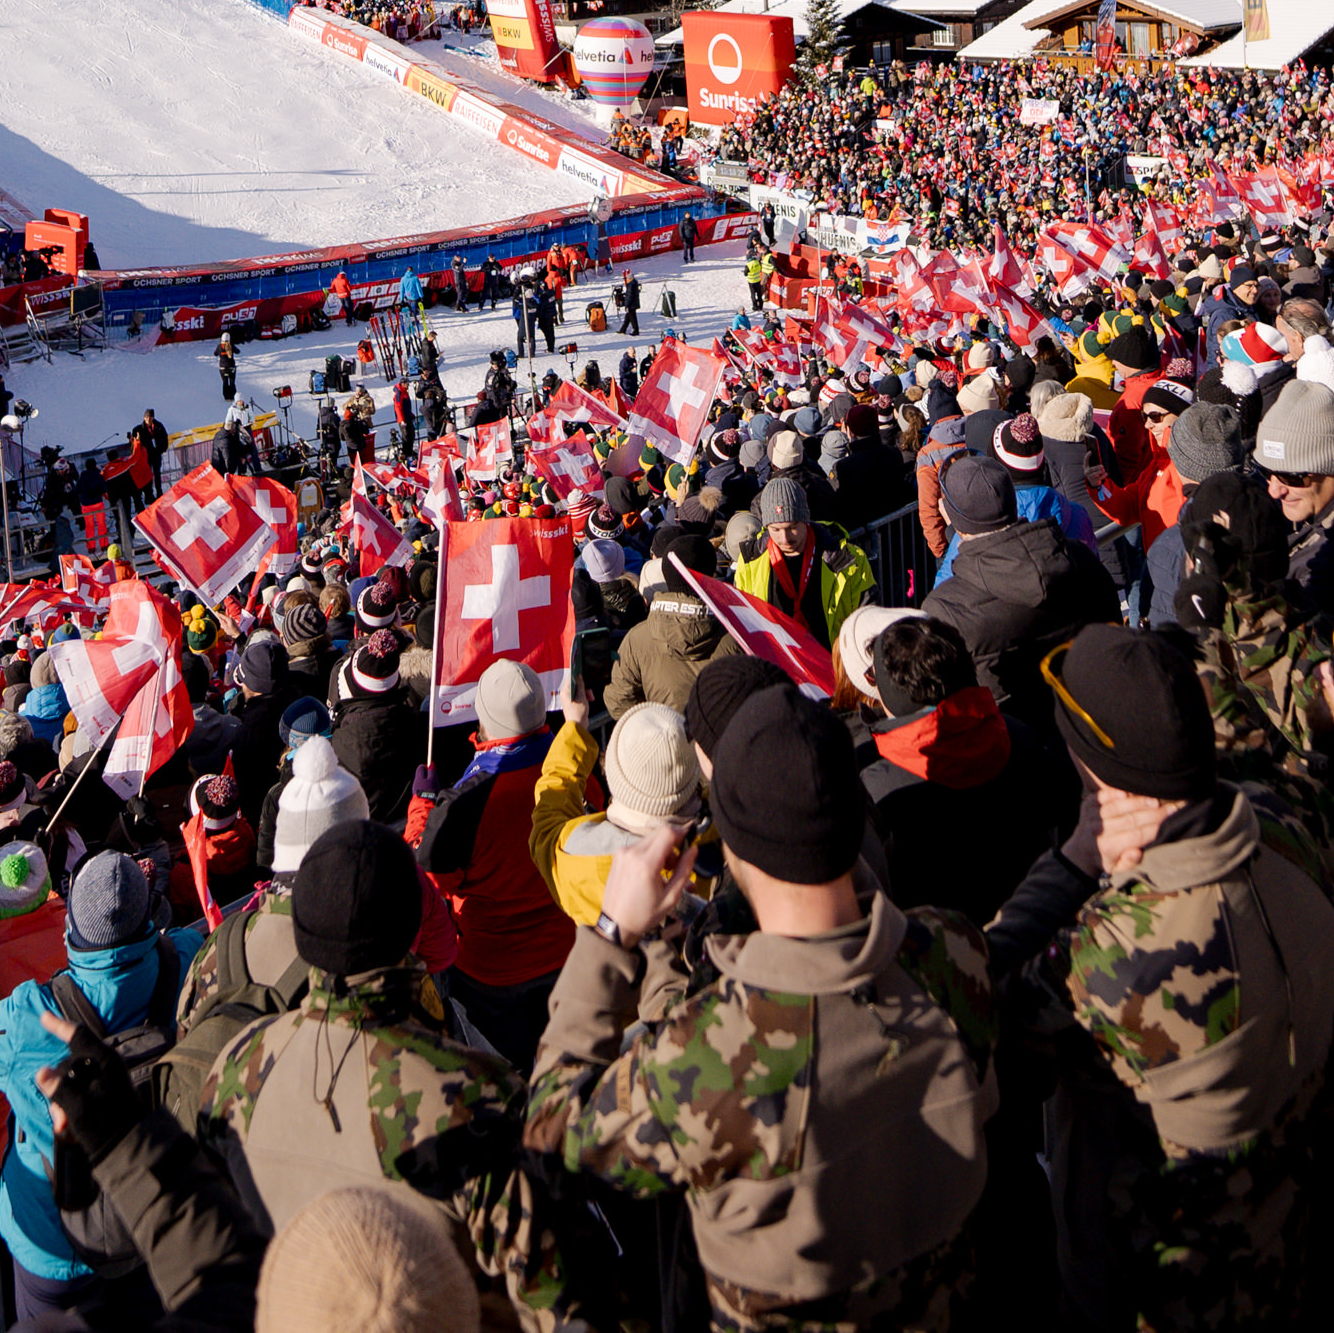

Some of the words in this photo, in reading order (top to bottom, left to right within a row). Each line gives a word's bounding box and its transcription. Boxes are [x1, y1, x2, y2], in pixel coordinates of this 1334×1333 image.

[290, 18, 322, 43] RAIFFEISEN
[502, 27, 521, 39] BKW
[334, 39, 358, 58] Sunrise
[366, 54, 393, 77] helvetia
[421, 81, 447, 107] BKW
[454, 101, 499, 139] RAIFFEISEN
[517, 136, 549, 162] Sunrise
[562, 159, 598, 187] helvetia
[409, 243, 430, 253] SPORT
[251, 268, 275, 277] SPORT
[321, 259, 345, 268] SPORT
[175, 276, 202, 284] SPORT
[530, 525, 569, 540] swissski
